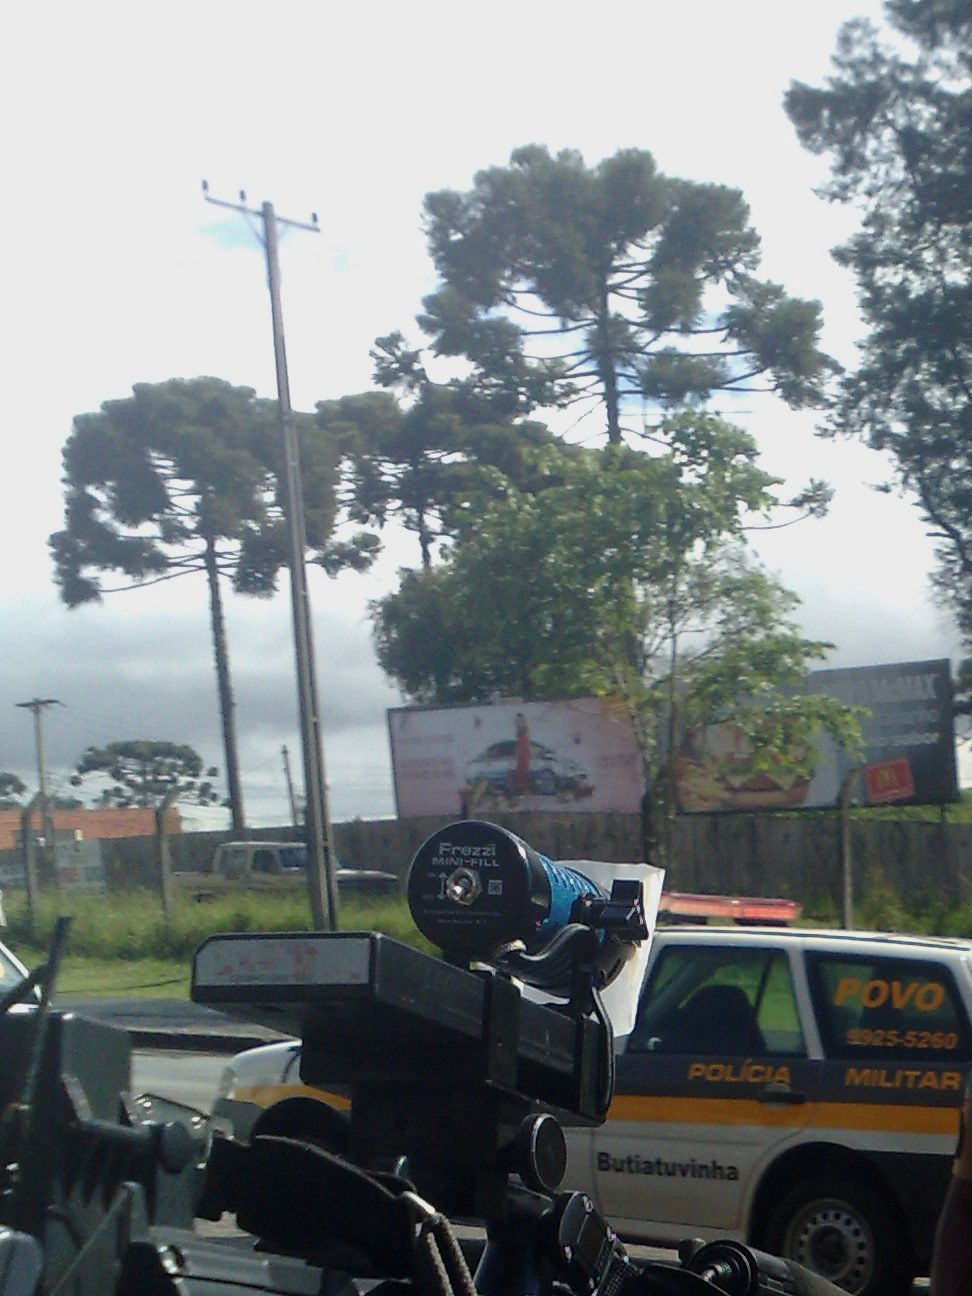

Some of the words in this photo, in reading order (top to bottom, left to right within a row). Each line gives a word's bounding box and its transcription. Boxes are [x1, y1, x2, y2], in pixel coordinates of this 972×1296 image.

[432, 857, 500, 867] MINI-FILL
[833, 978, 945, 1012] POVO
[845, 1067, 961, 1089] MILITAR
[597, 1152, 739, 1181] Butiatuvinha
